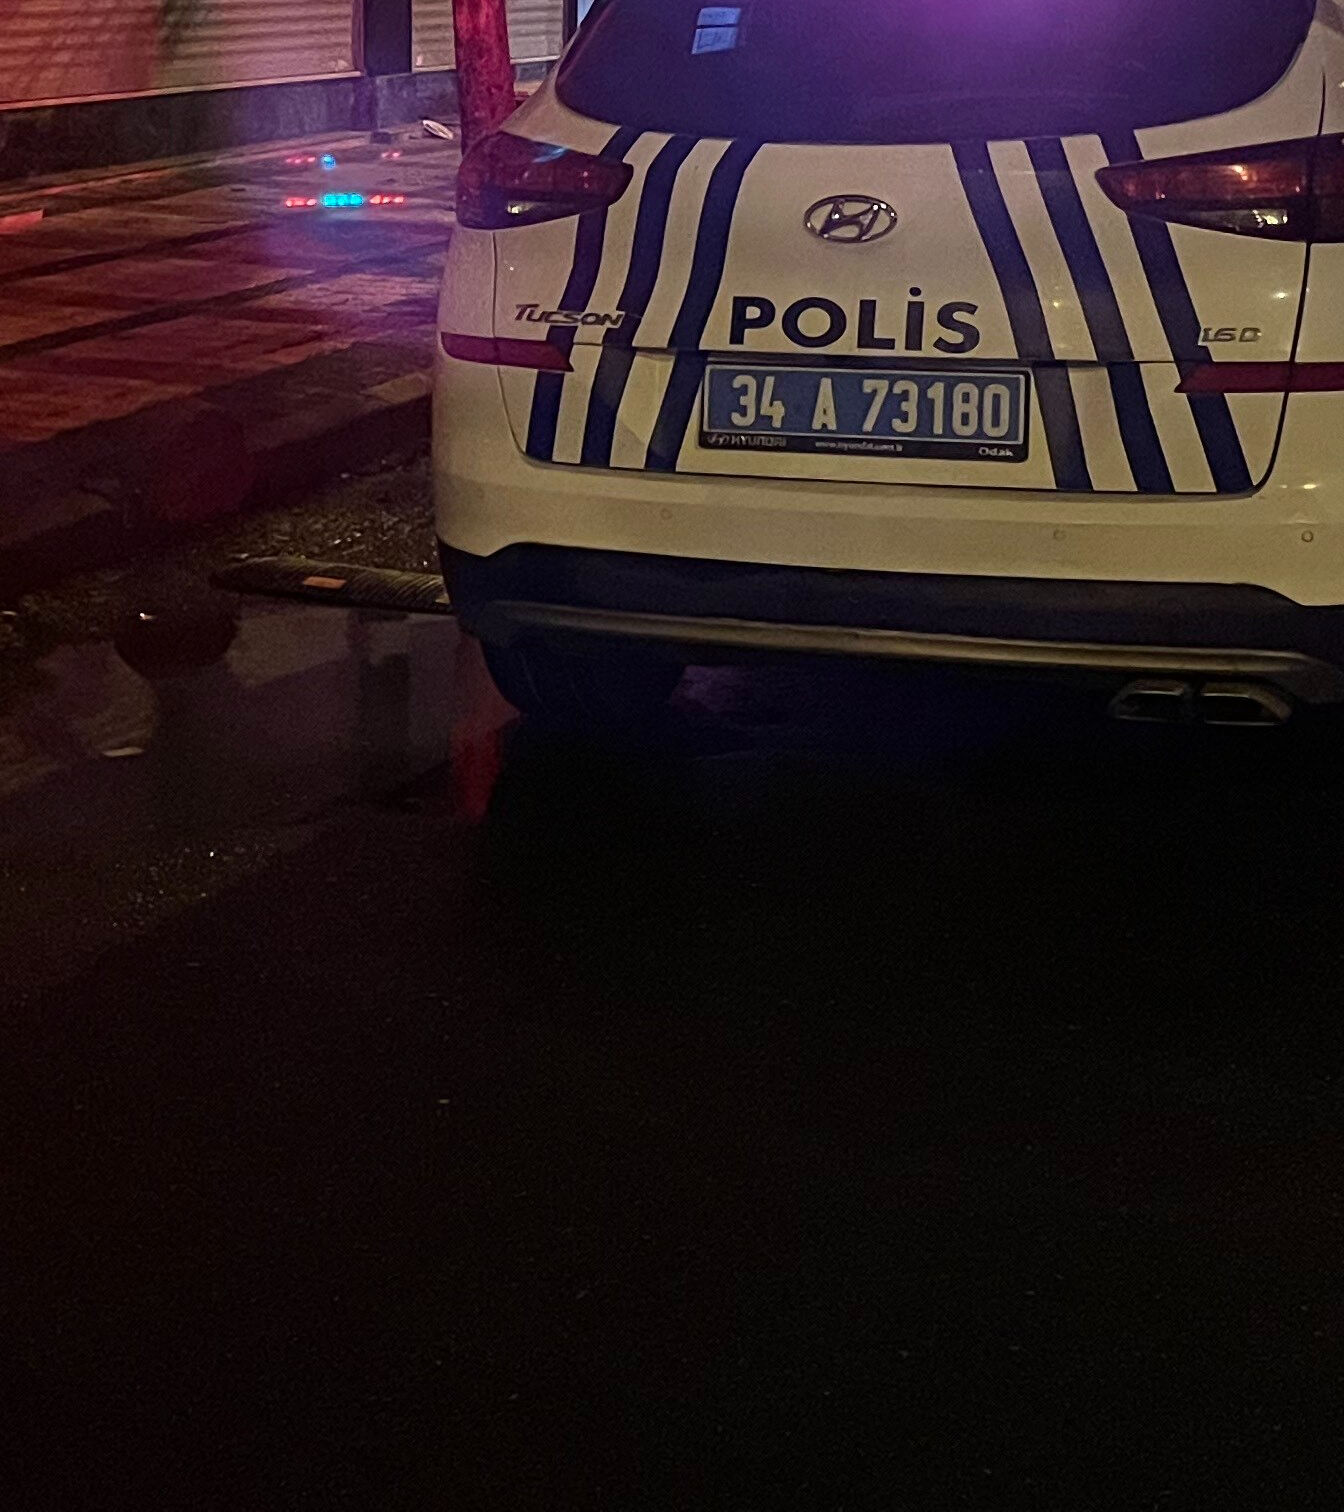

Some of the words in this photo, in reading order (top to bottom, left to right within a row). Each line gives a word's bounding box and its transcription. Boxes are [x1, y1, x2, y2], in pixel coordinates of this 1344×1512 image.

[514, 303, 624, 326] TUCSON
[729, 286, 981, 354] POLİS
[730, 374, 786, 428] 34
[811, 377, 838, 431] A
[862, 379, 1011, 438] 73180
